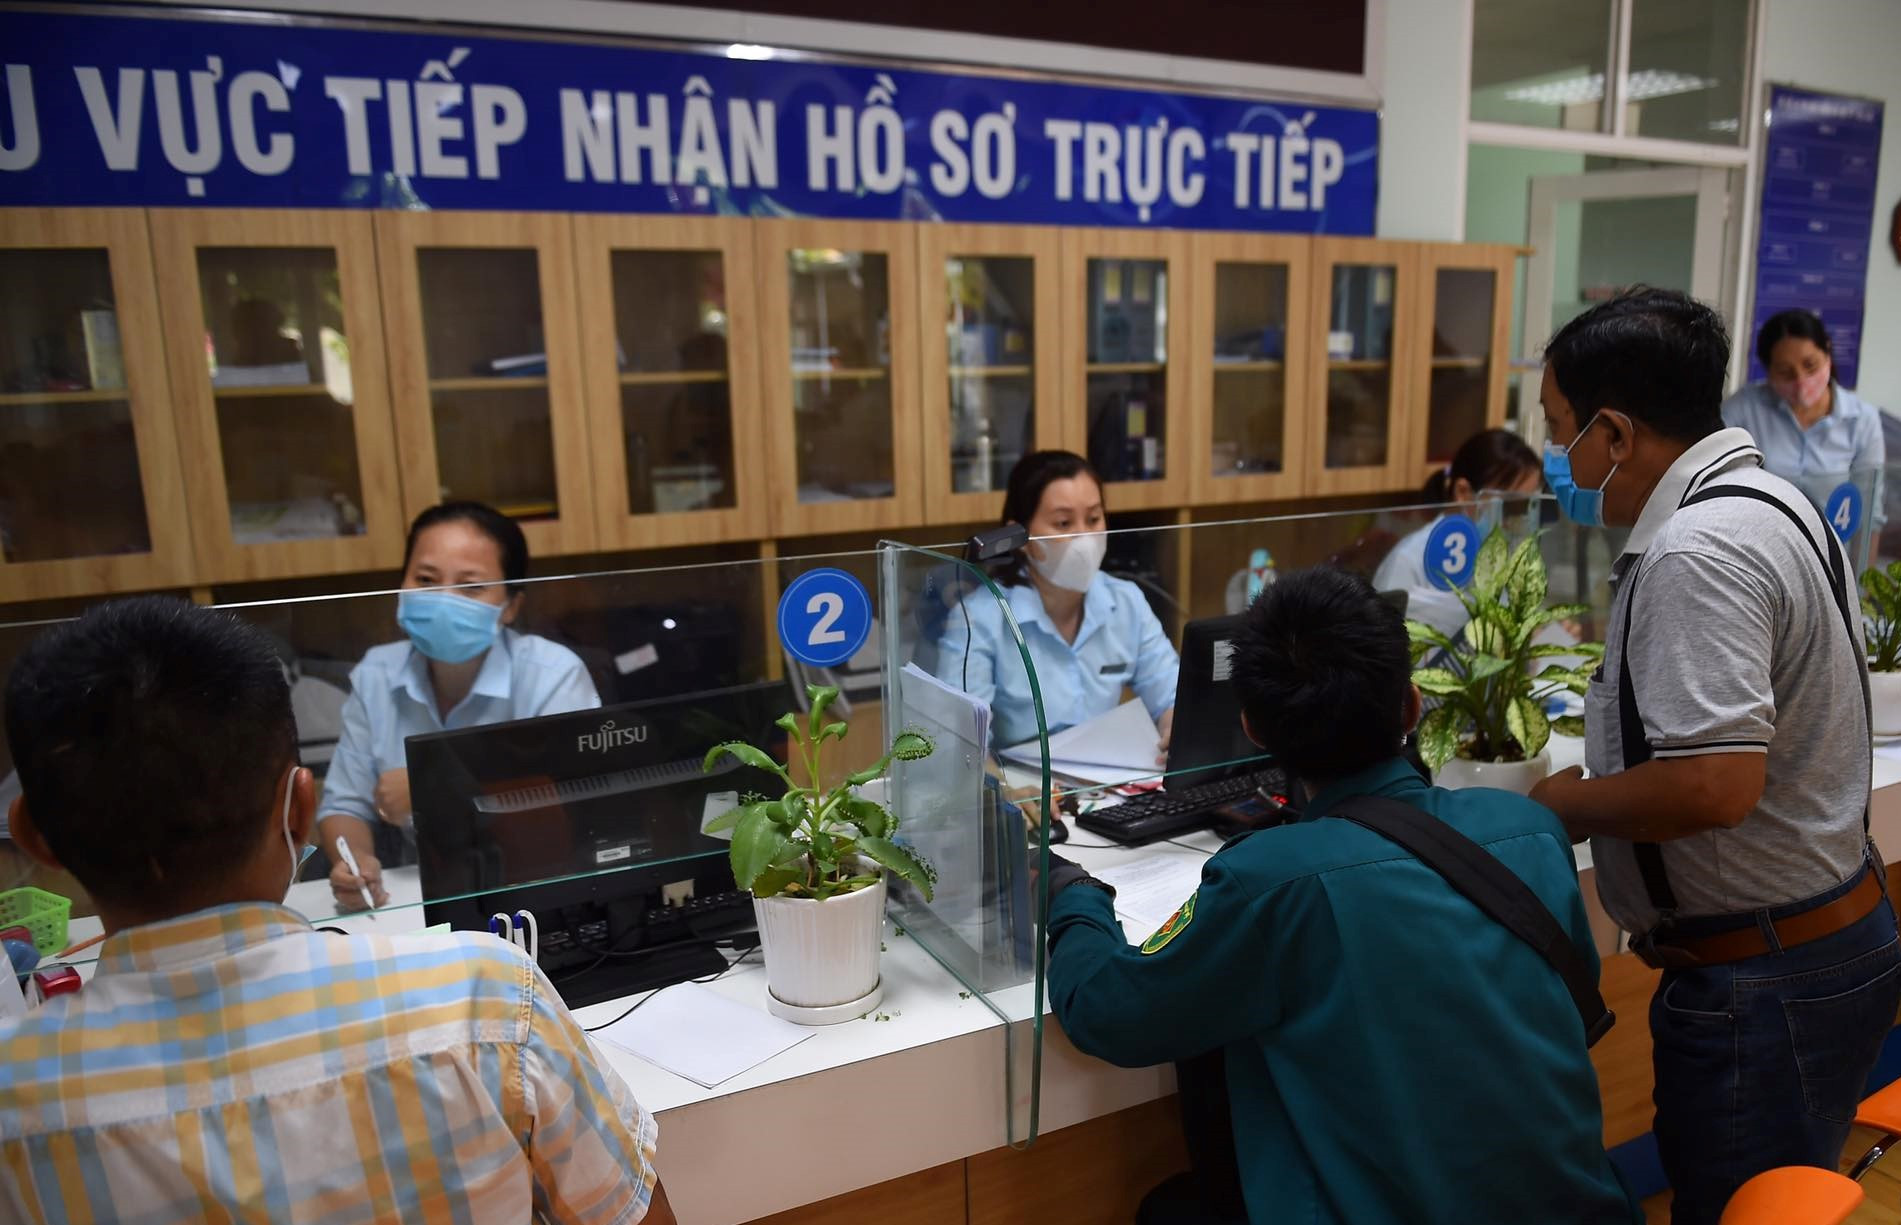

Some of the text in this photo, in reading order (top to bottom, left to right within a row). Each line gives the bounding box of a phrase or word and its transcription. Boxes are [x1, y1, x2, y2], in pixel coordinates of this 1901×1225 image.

[73, 55, 295, 197] VỰC
[324, 47, 528, 180] TIẾP
[559, 75, 779, 205] NHẬN
[806, 74, 905, 194] HỒ
[930, 102, 1016, 199] SƠ
[1045, 117, 1206, 222] TRỰC
[1227, 111, 1344, 211] TIẾP
[1834, 496, 1851, 531] 4
[1442, 532, 1466, 575] 3
[806, 592, 845, 646] 2
[578, 720, 648, 752] FUJITSU
